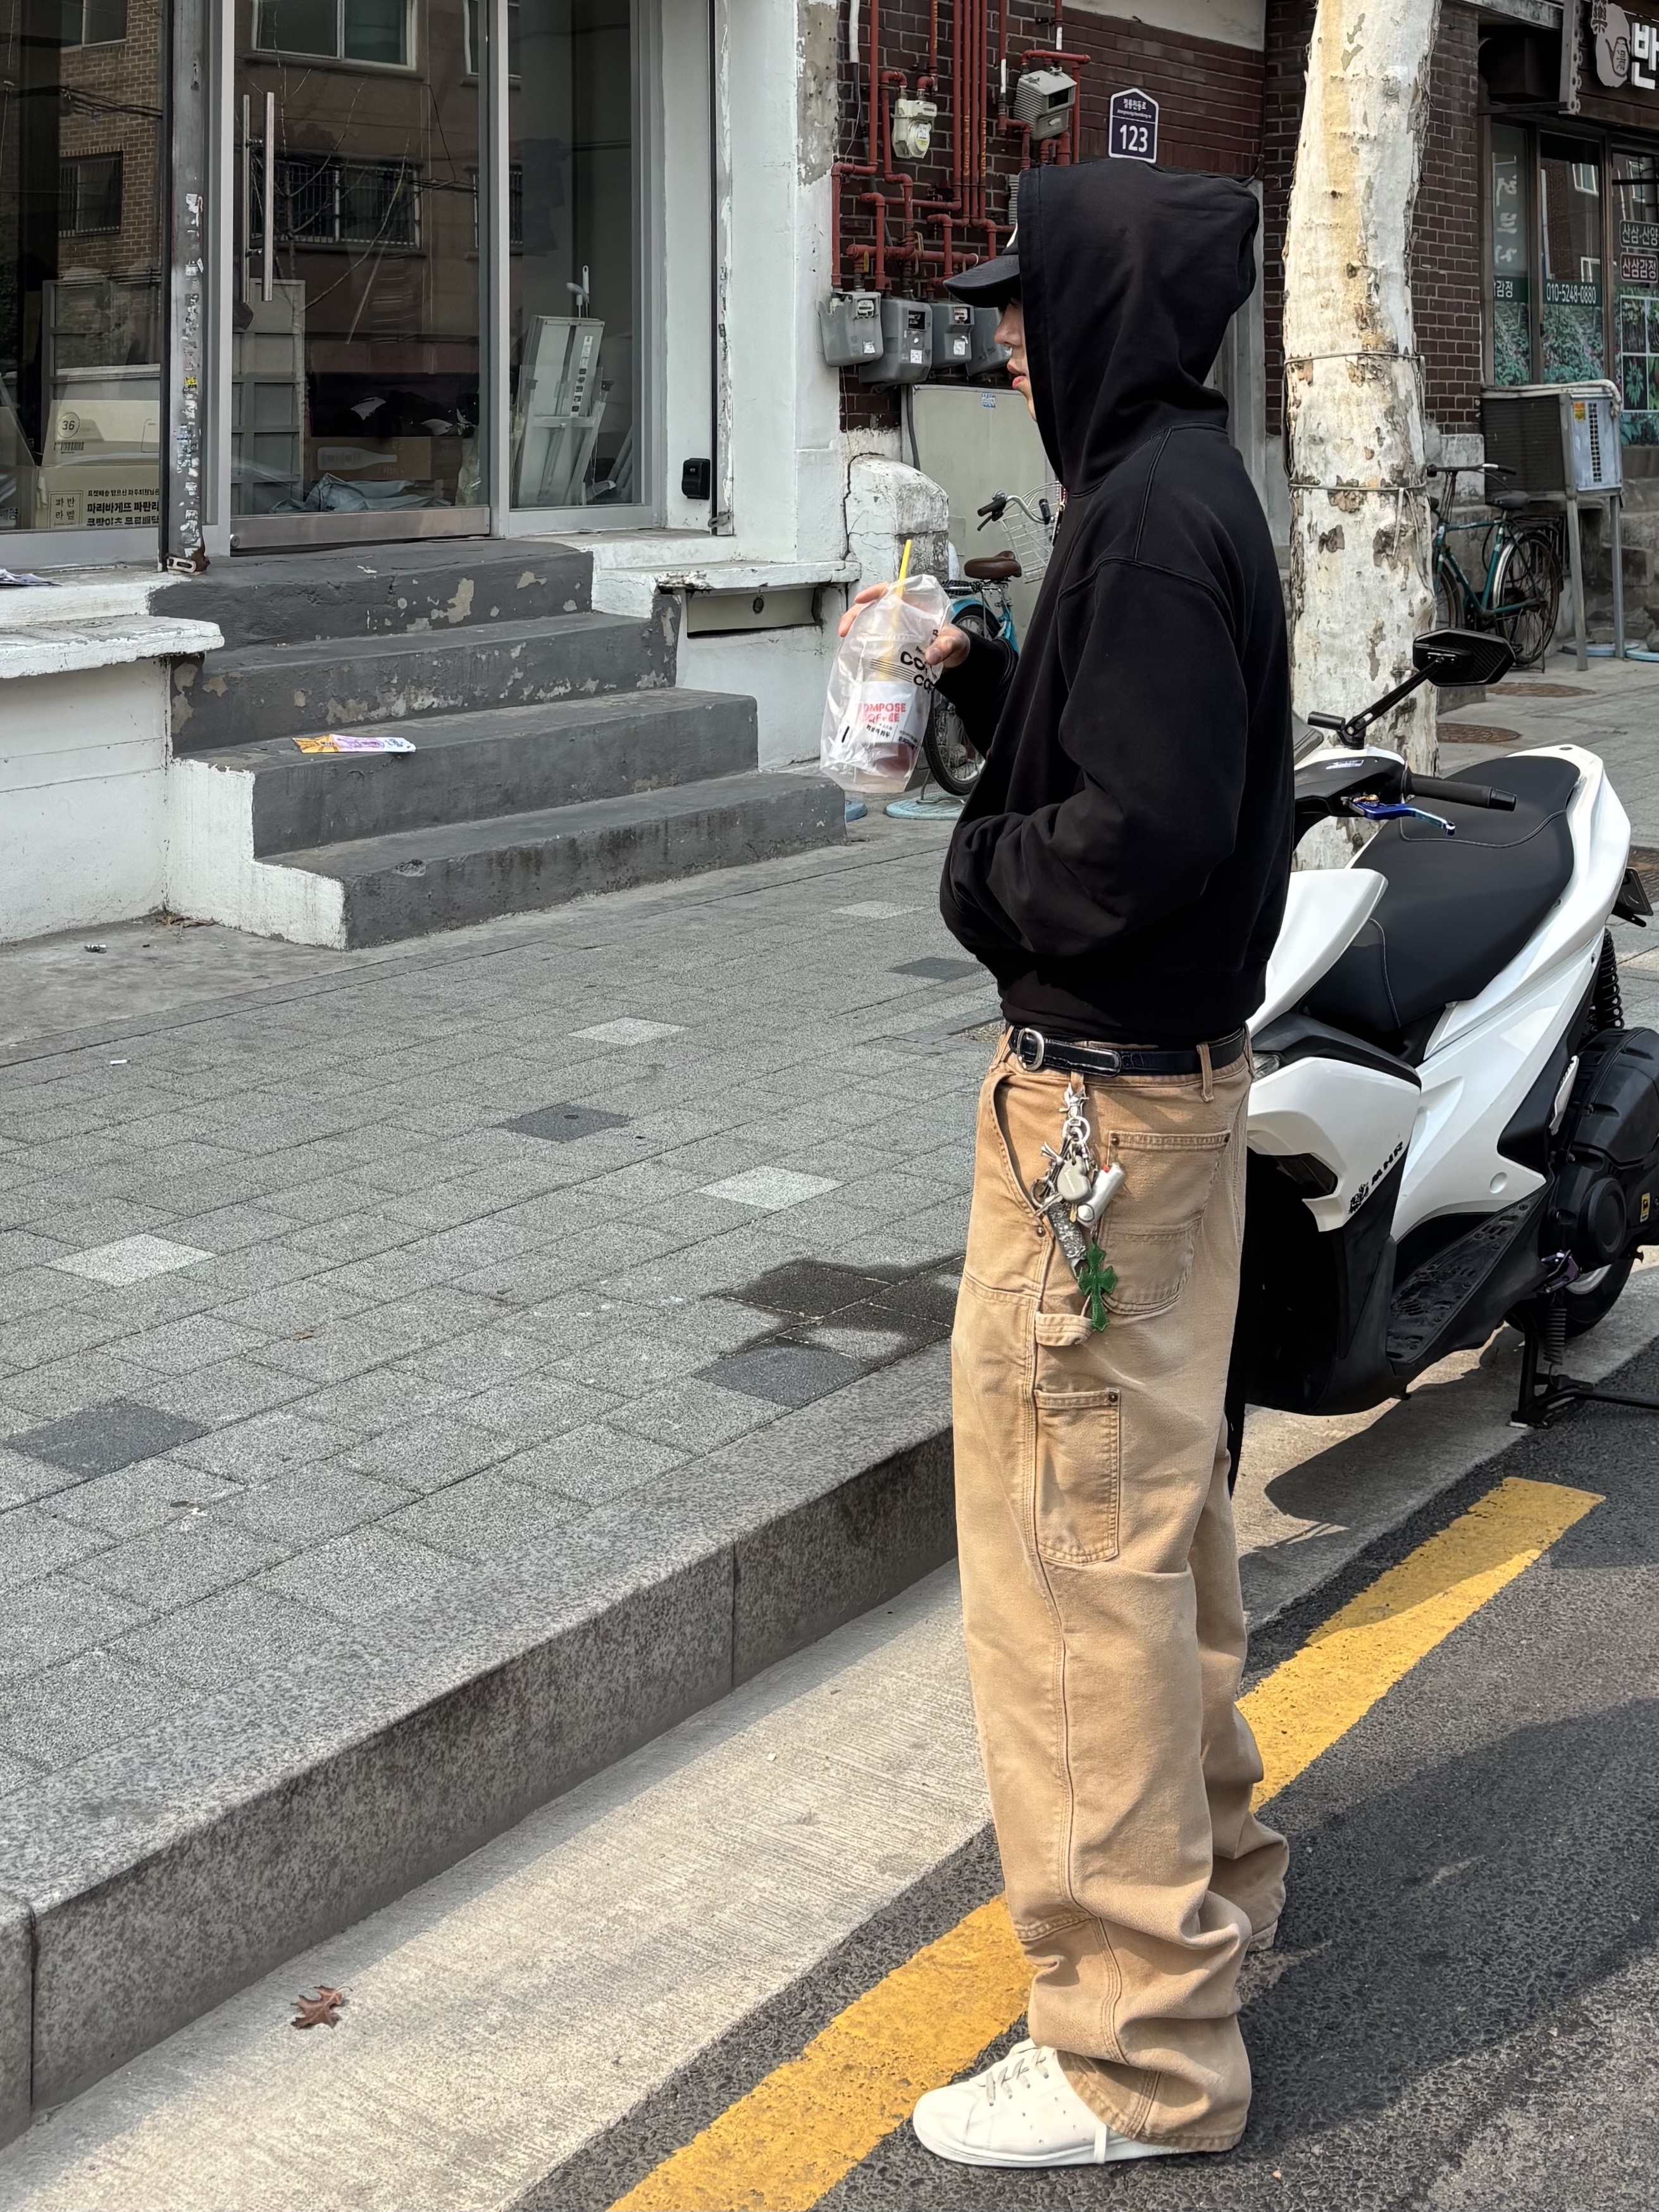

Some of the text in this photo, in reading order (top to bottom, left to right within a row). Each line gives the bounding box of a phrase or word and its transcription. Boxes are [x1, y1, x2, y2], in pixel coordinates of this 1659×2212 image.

[1119, 124, 1148, 153] 123
[1622, 258, 1656, 279] 산삼감정
[1494, 280, 1513, 298] 감정
[61, 420, 75, 430] 36
